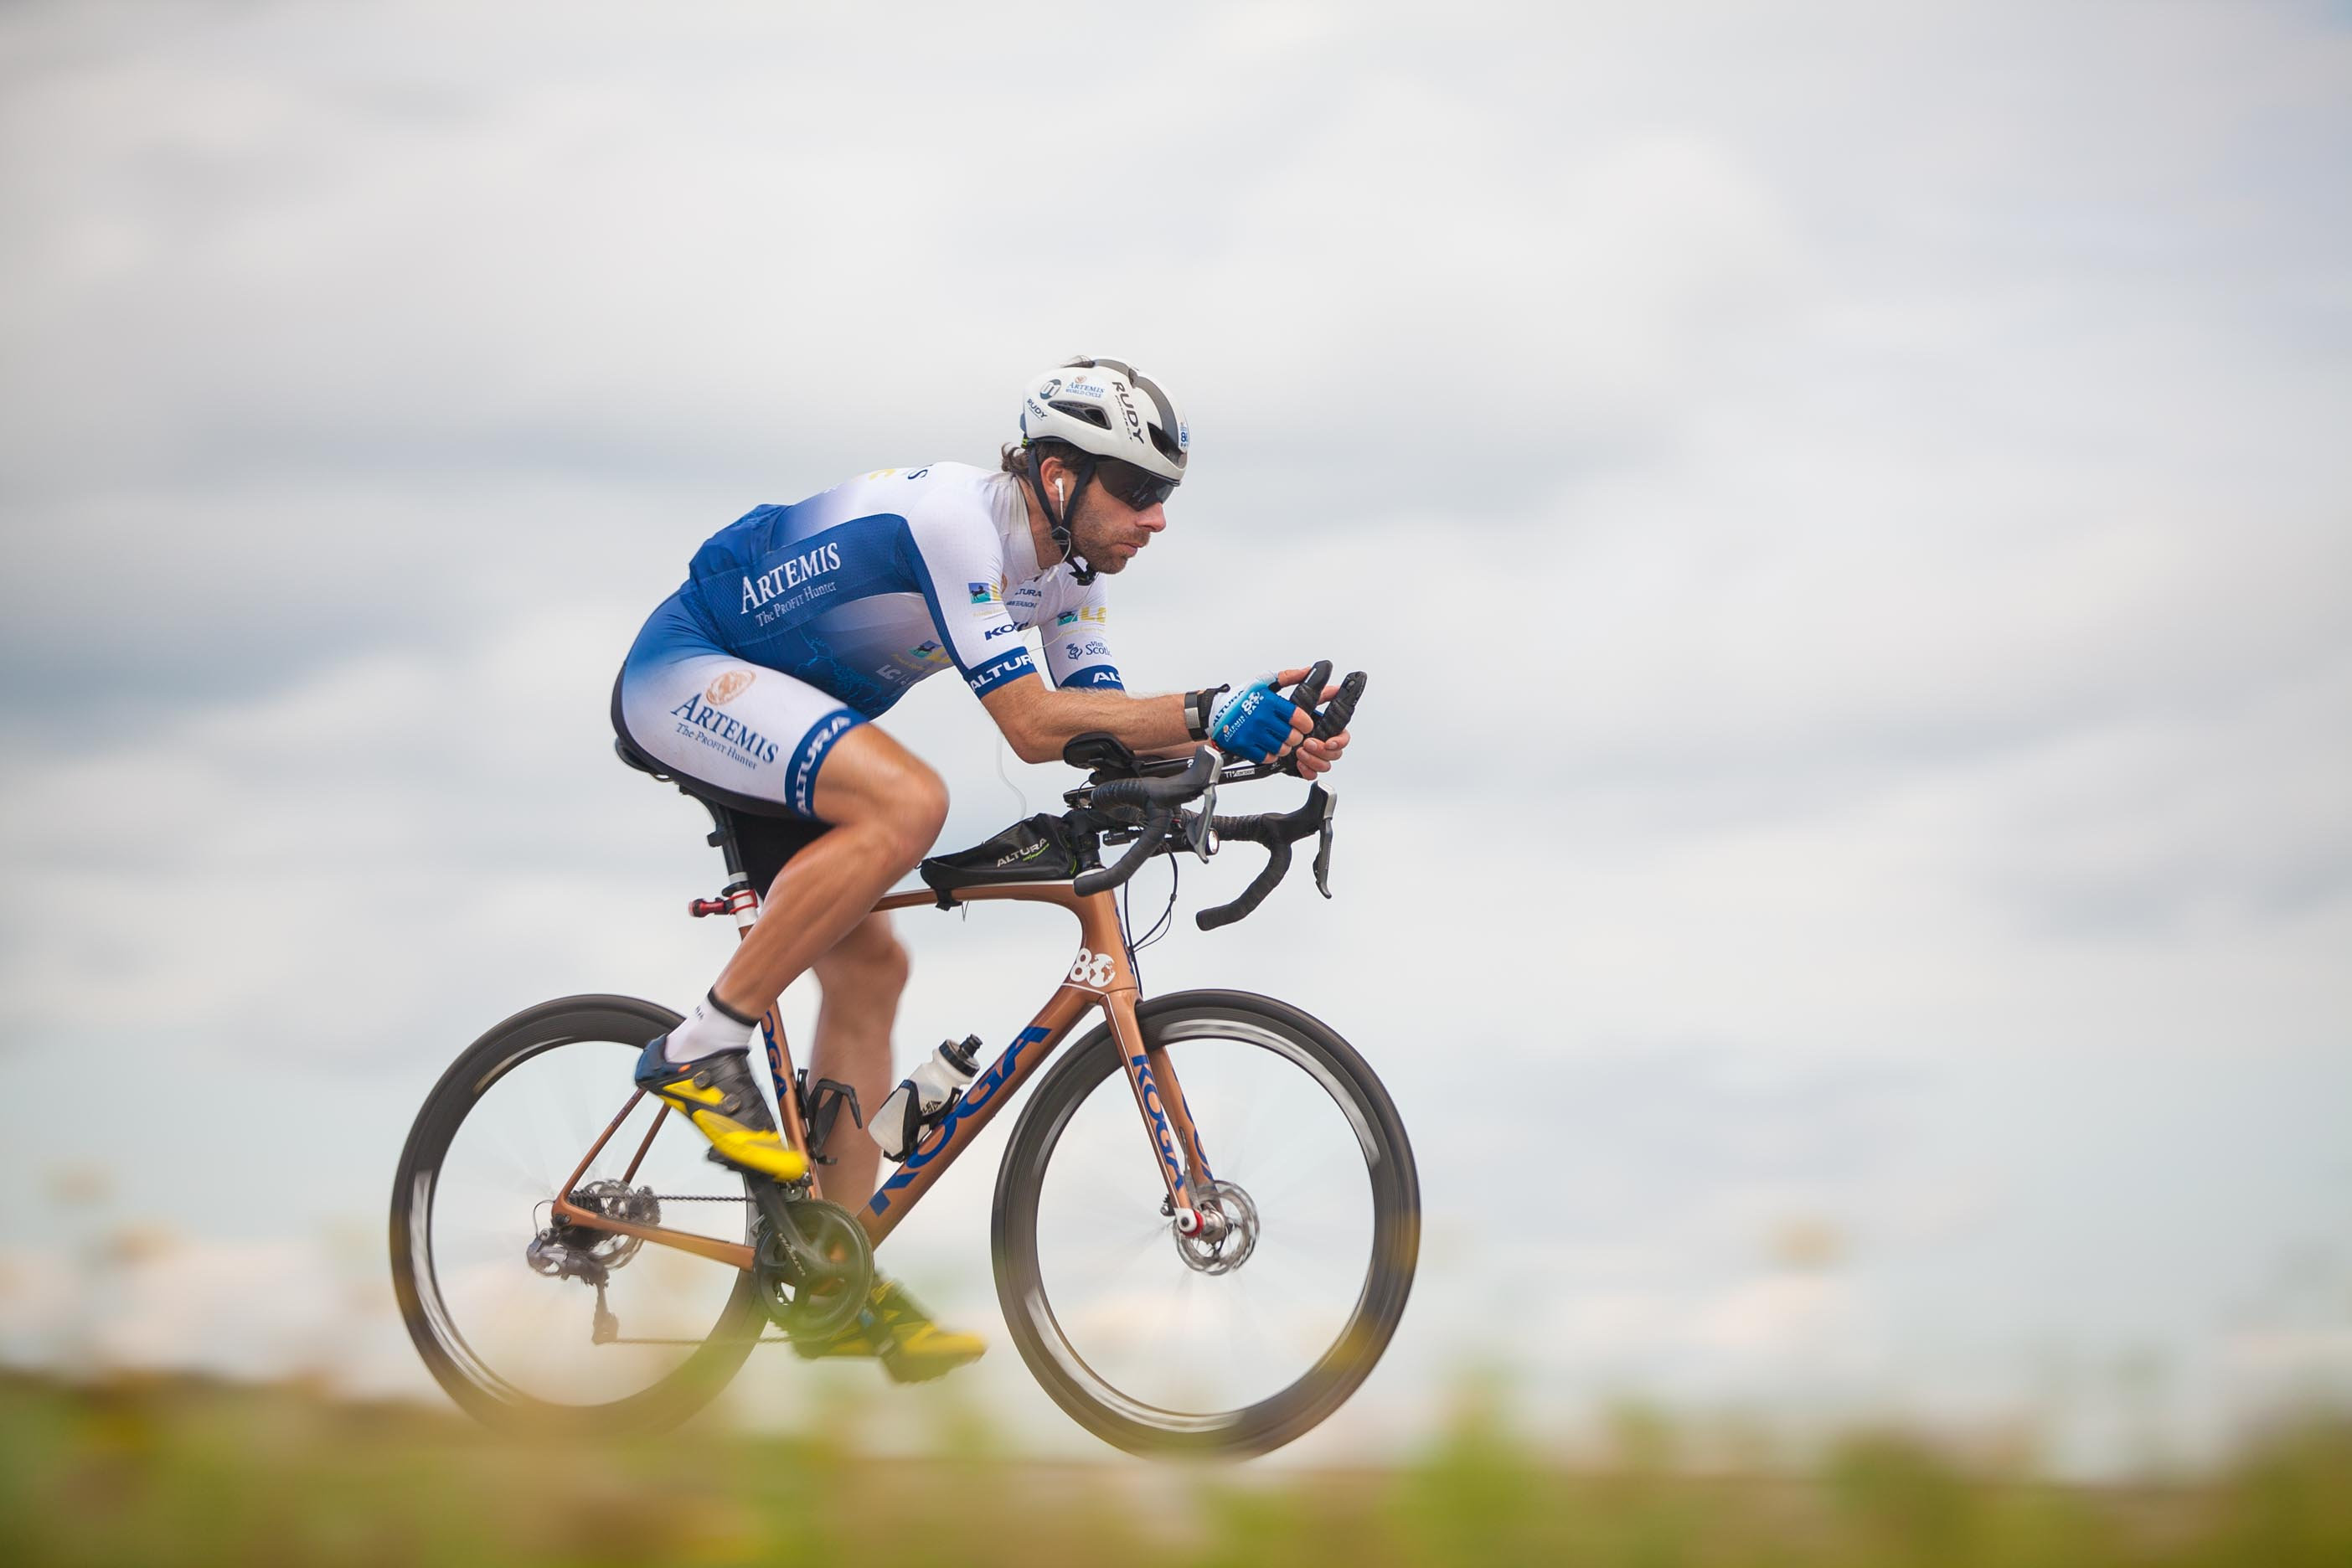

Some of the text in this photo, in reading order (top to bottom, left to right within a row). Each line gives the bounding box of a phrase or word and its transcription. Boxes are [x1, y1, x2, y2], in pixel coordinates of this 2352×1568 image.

[1027, 398, 1048, 419] RUDY
[1067, 382, 1105, 394] ARTEMIS
[1112, 381, 1144, 445] RUDY
[740, 542, 842, 615] ARTEMIS
[756, 581, 837, 627] The PROFIT Hunter
[671, 693, 780, 765] ARTEMIS
[676, 722, 758, 771] The PROFIT Hunter
[997, 838, 1048, 868] ALTURA
[765, 1009, 787, 1102] OGA
[1132, 1054, 1184, 1192] KOGA
